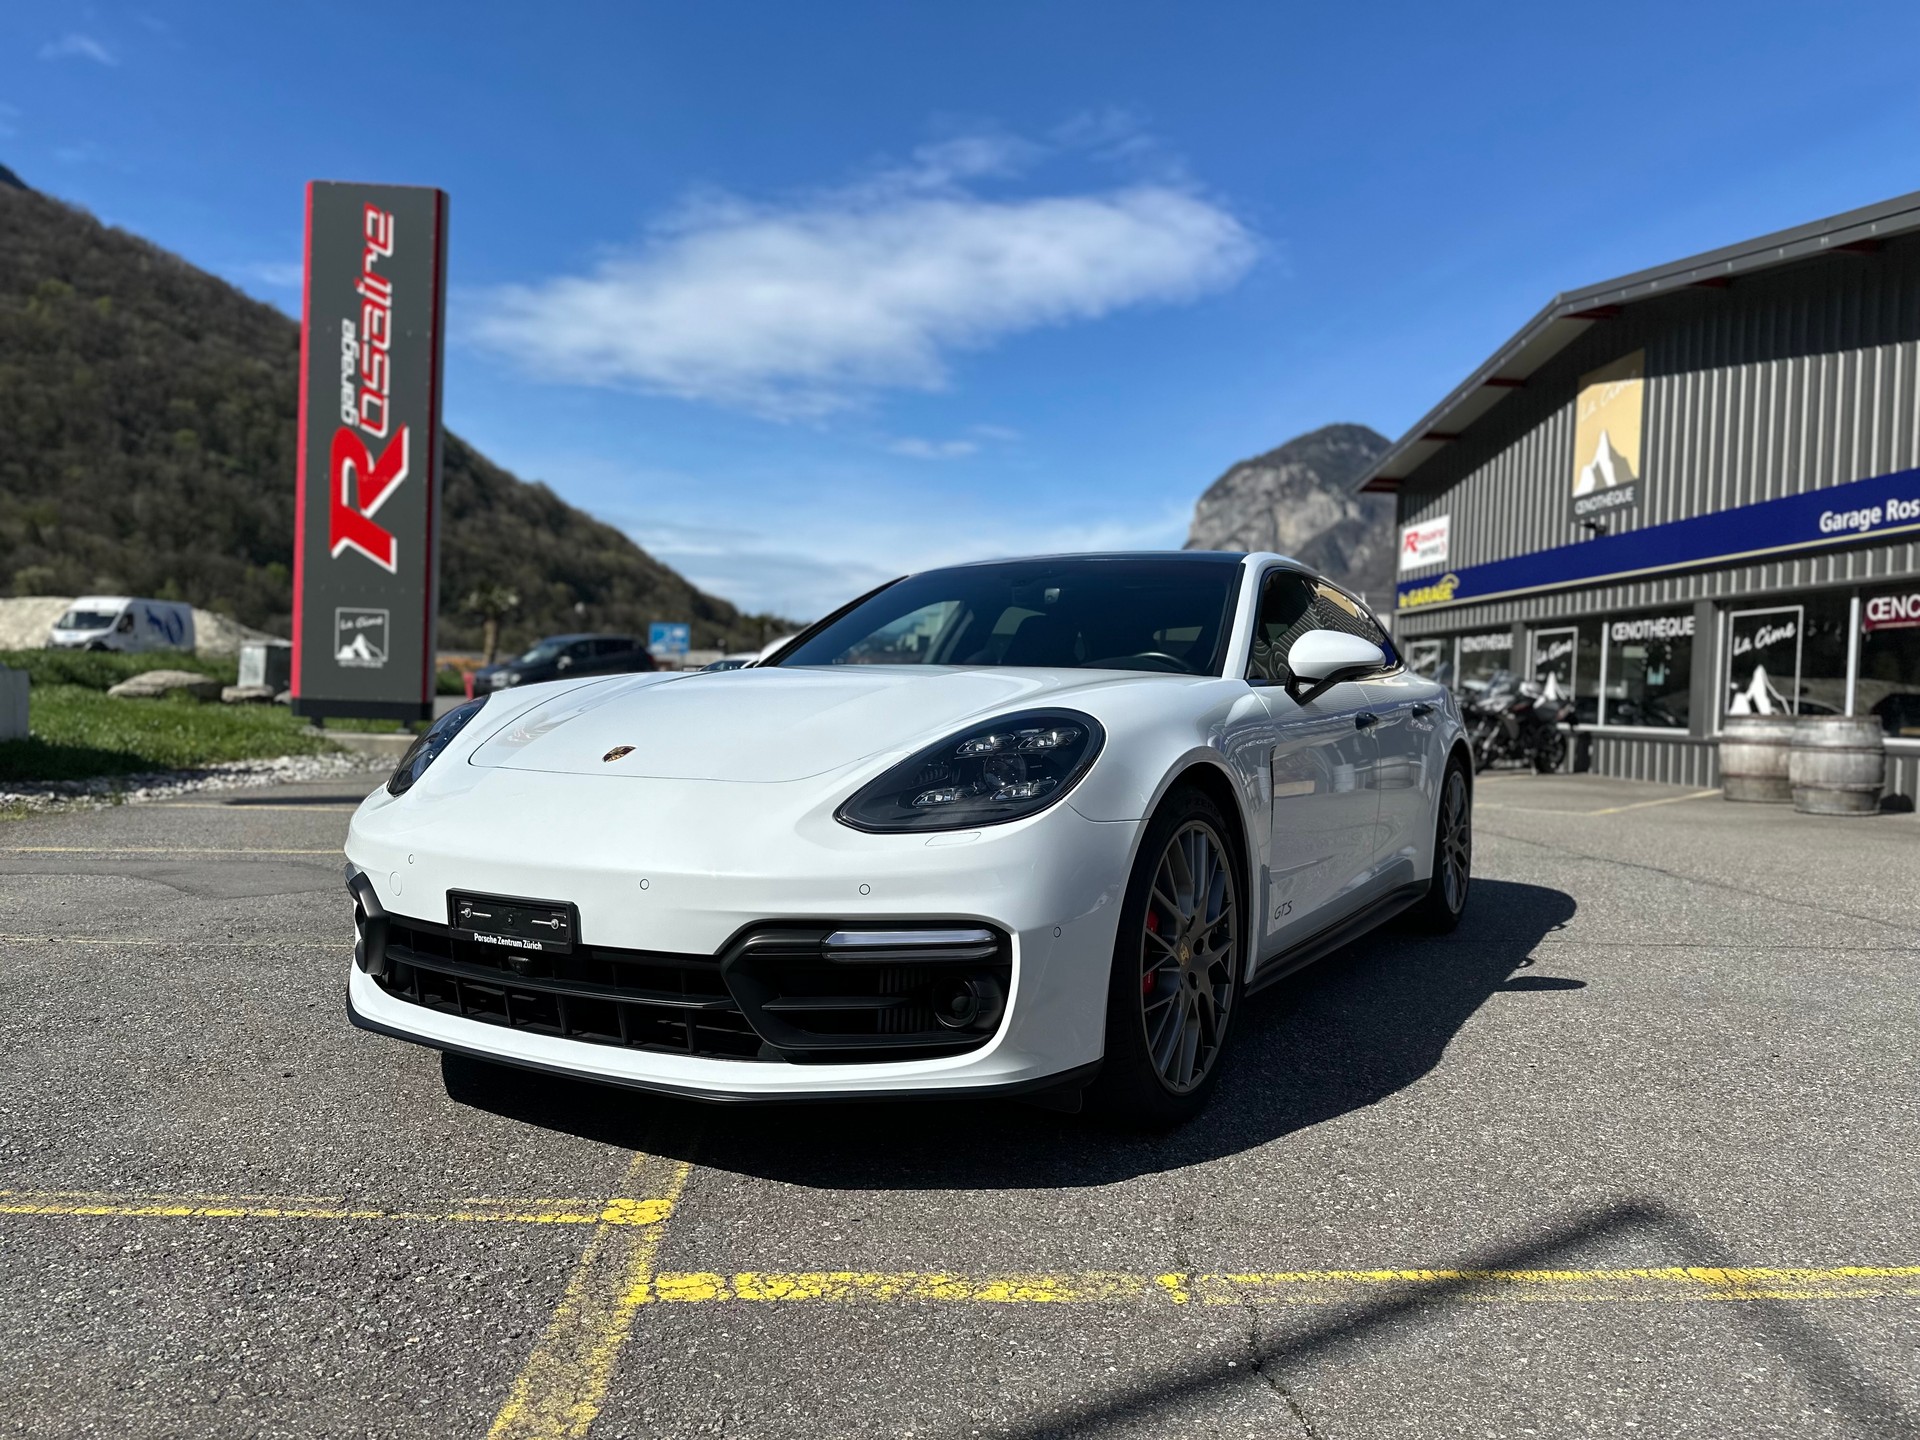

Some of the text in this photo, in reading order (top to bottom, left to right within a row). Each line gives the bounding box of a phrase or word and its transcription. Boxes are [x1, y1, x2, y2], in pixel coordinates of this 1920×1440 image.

[329, 201, 410, 575] Rosaire
[341, 317, 361, 428] garage
[1819, 498, 1920, 534] Garage Ros
[1408, 583, 1454, 607] GARAGE
[1734, 621, 1796, 656] La Cime
[1274, 900, 1293, 920] GTS
[473, 932, 543, 951] Porsche Zentrum Zürich
